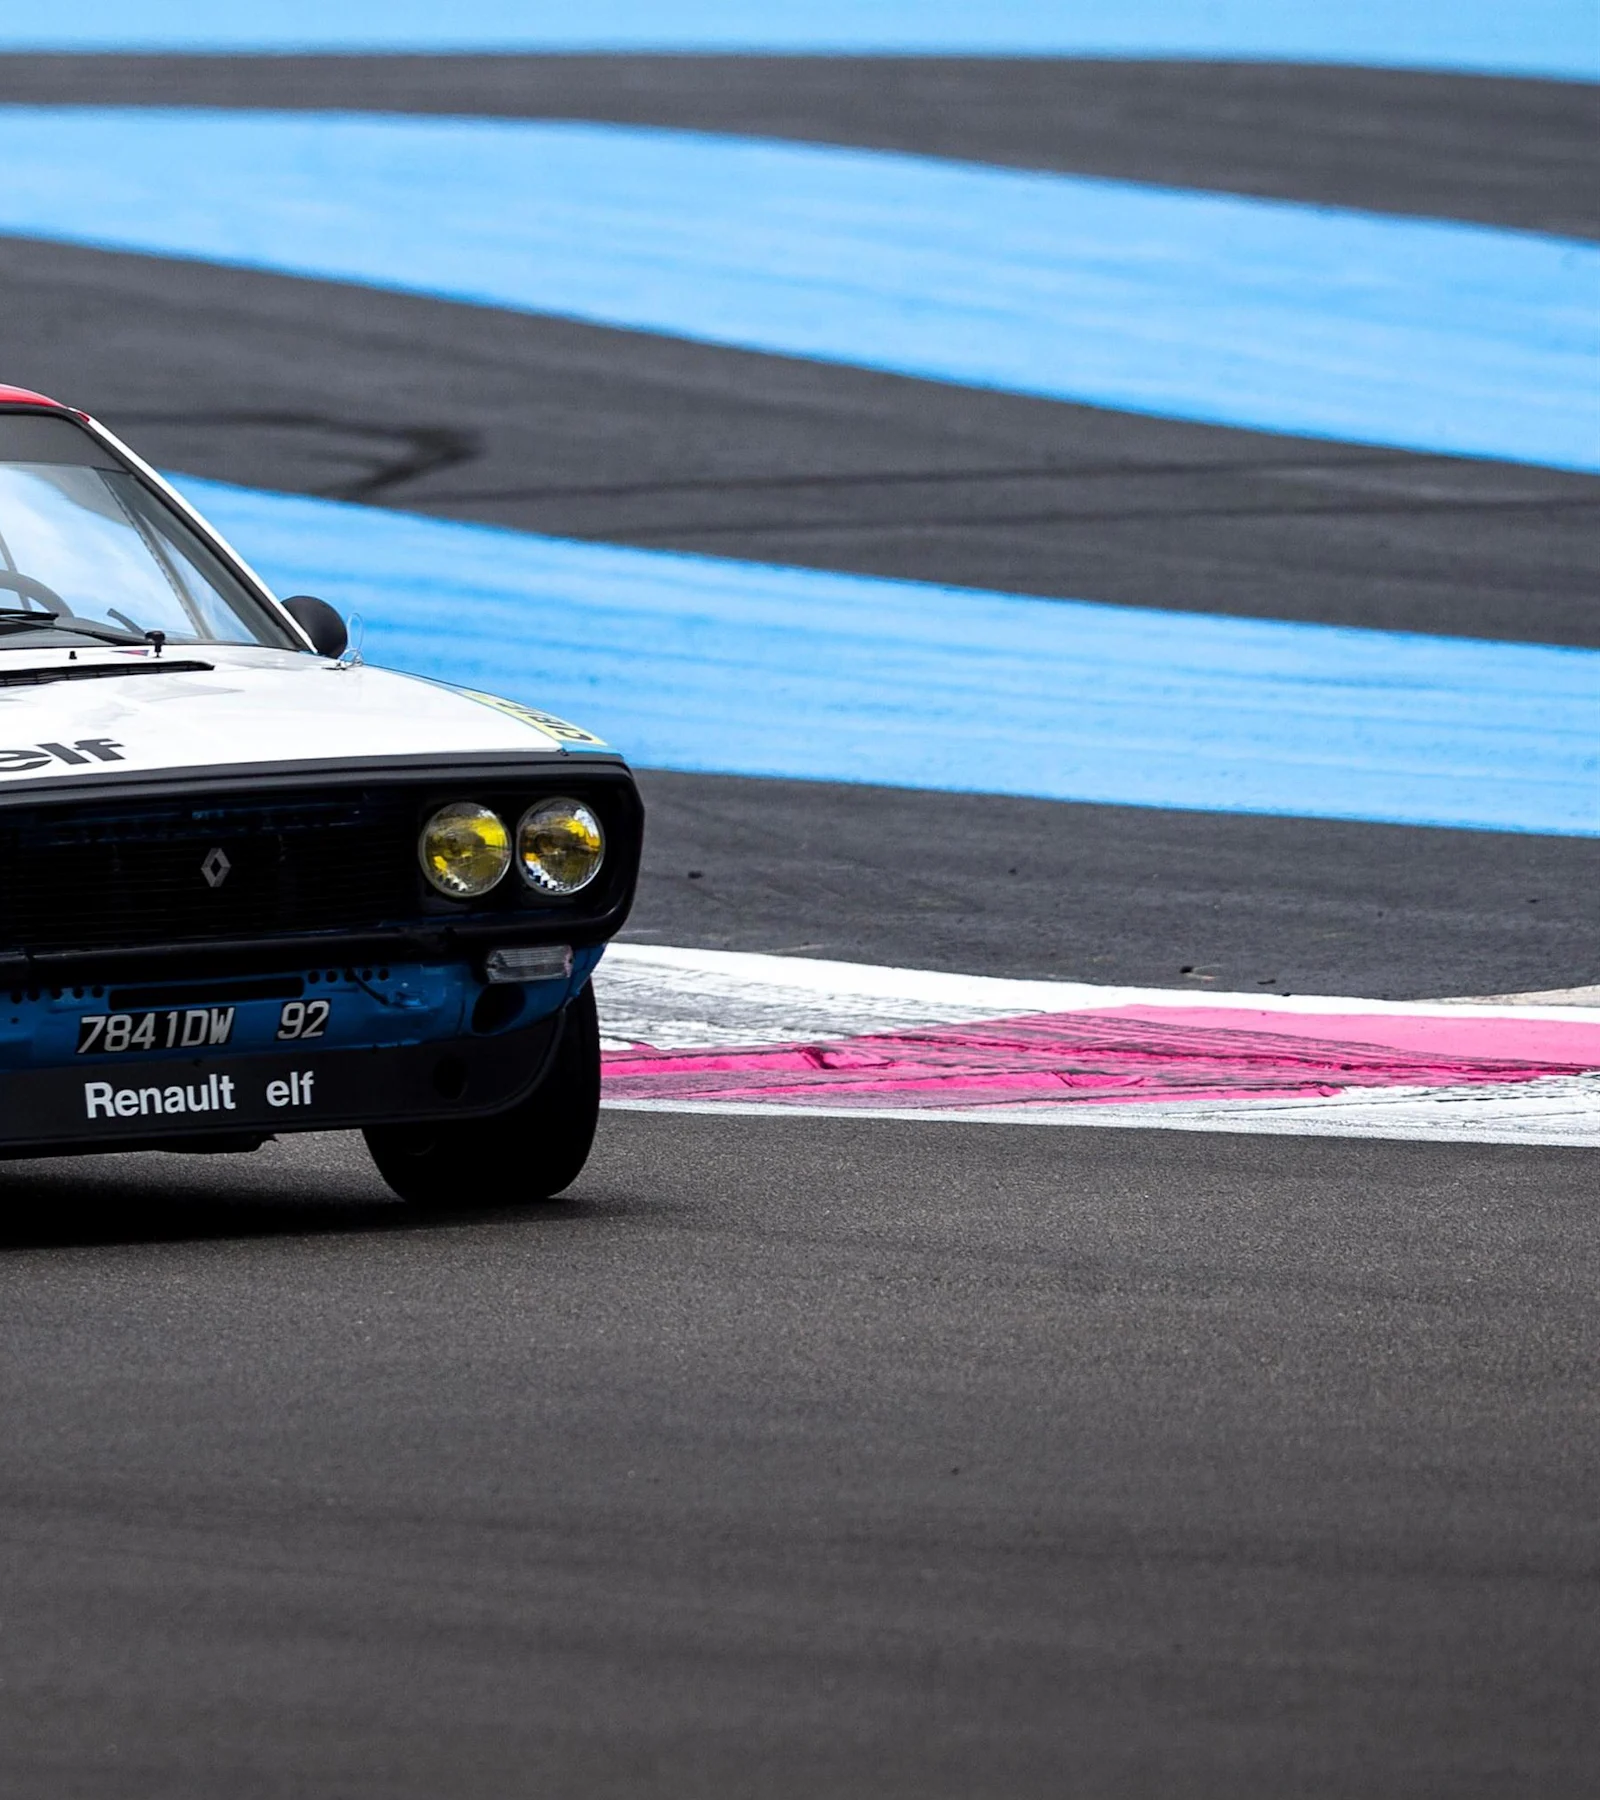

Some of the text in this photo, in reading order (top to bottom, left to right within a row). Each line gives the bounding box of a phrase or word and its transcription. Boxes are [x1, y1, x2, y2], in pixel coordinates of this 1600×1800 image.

[277, 1000, 330, 1039] 92
[85, 1071, 314, 1118] Renault elf
